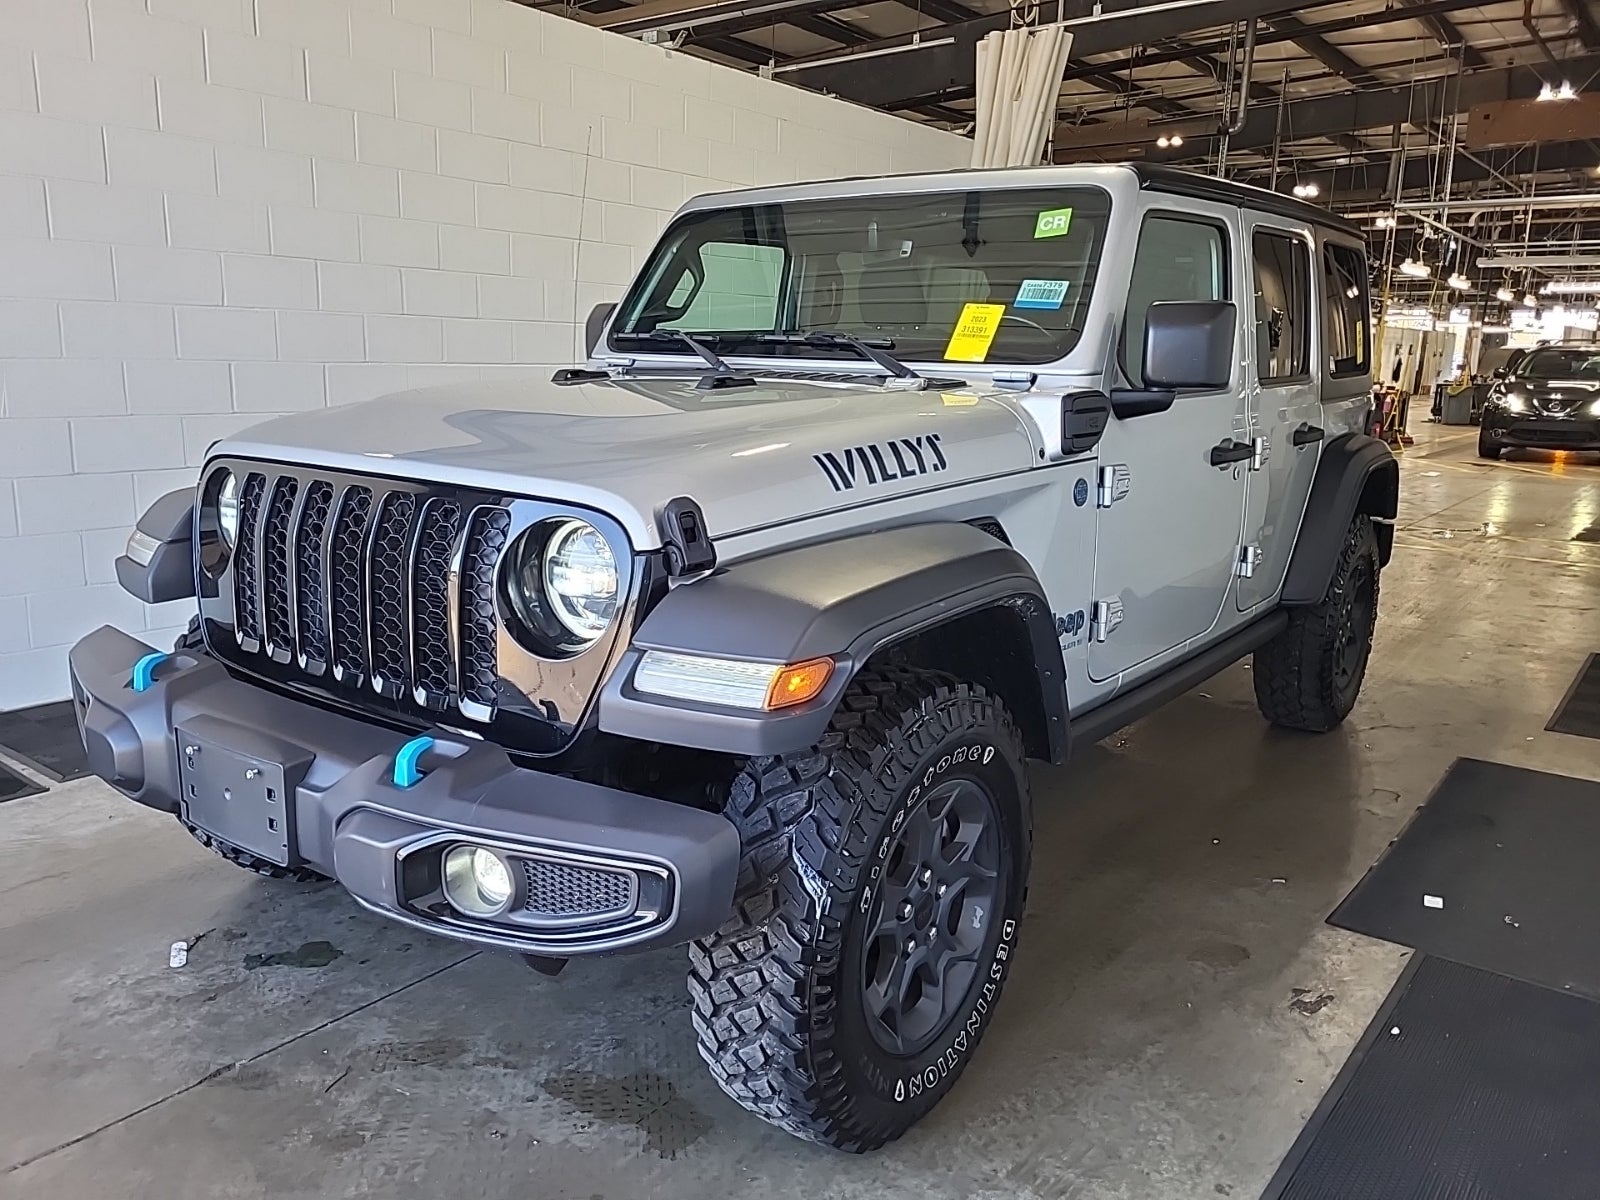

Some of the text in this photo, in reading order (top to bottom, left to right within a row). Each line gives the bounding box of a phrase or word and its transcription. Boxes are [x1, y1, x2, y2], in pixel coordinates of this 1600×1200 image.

[1039, 215, 1067, 231] CR
[970, 315, 987, 323] 2023
[961, 325, 988, 334] 313391
[812, 433, 947, 492] WILLYS
[908, 919, 1016, 1098] DESTINATION
